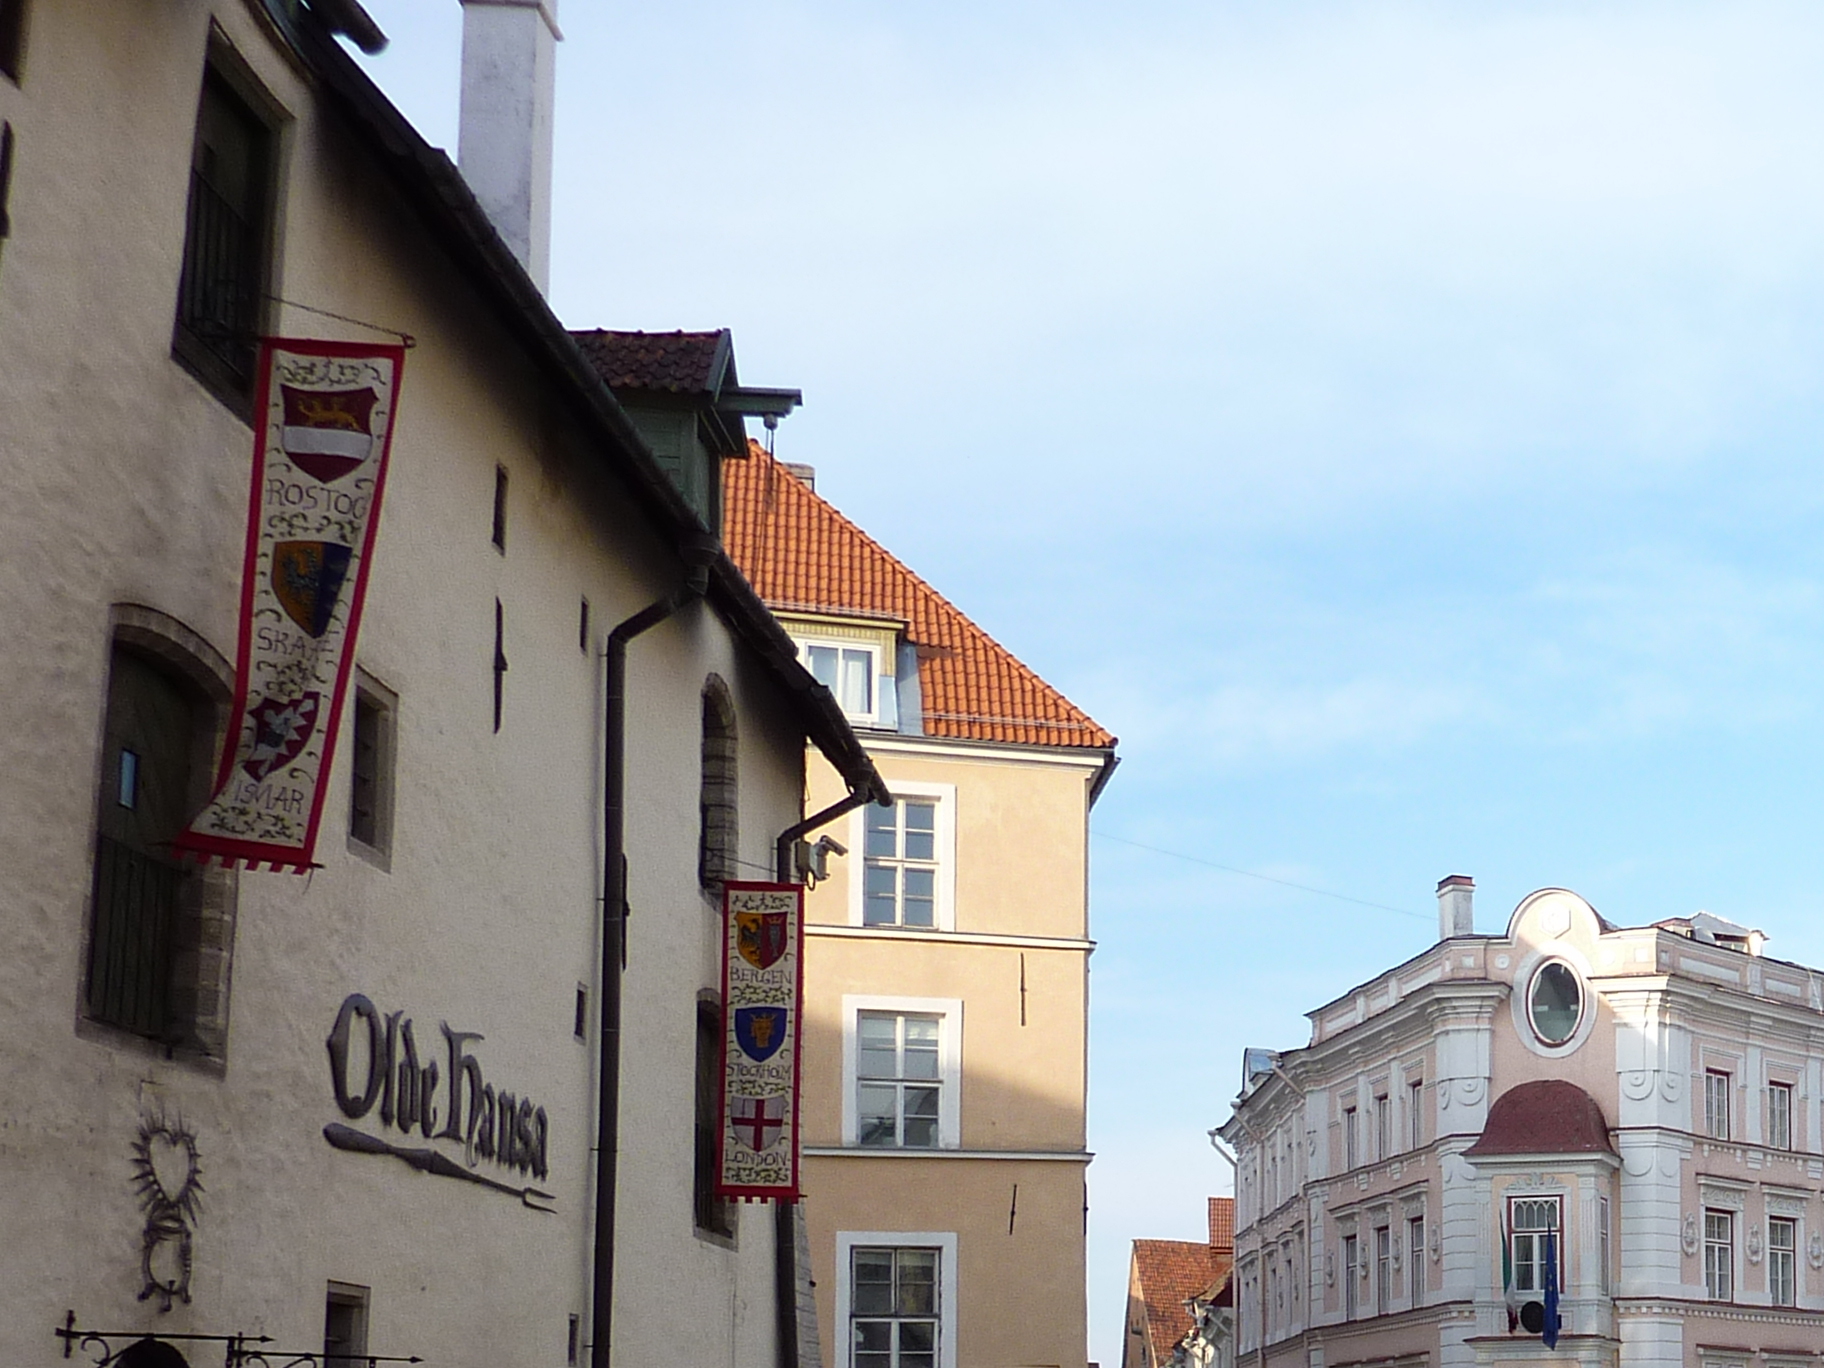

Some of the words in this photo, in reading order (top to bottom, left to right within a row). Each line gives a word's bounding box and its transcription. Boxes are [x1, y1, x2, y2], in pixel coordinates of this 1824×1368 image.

[730, 966, 792, 986] BERGEN
[326, 993, 439, 1139] Olde
[726, 1062, 792, 1081] STOCKHOLM
[725, 1150, 787, 1168] LONDON
